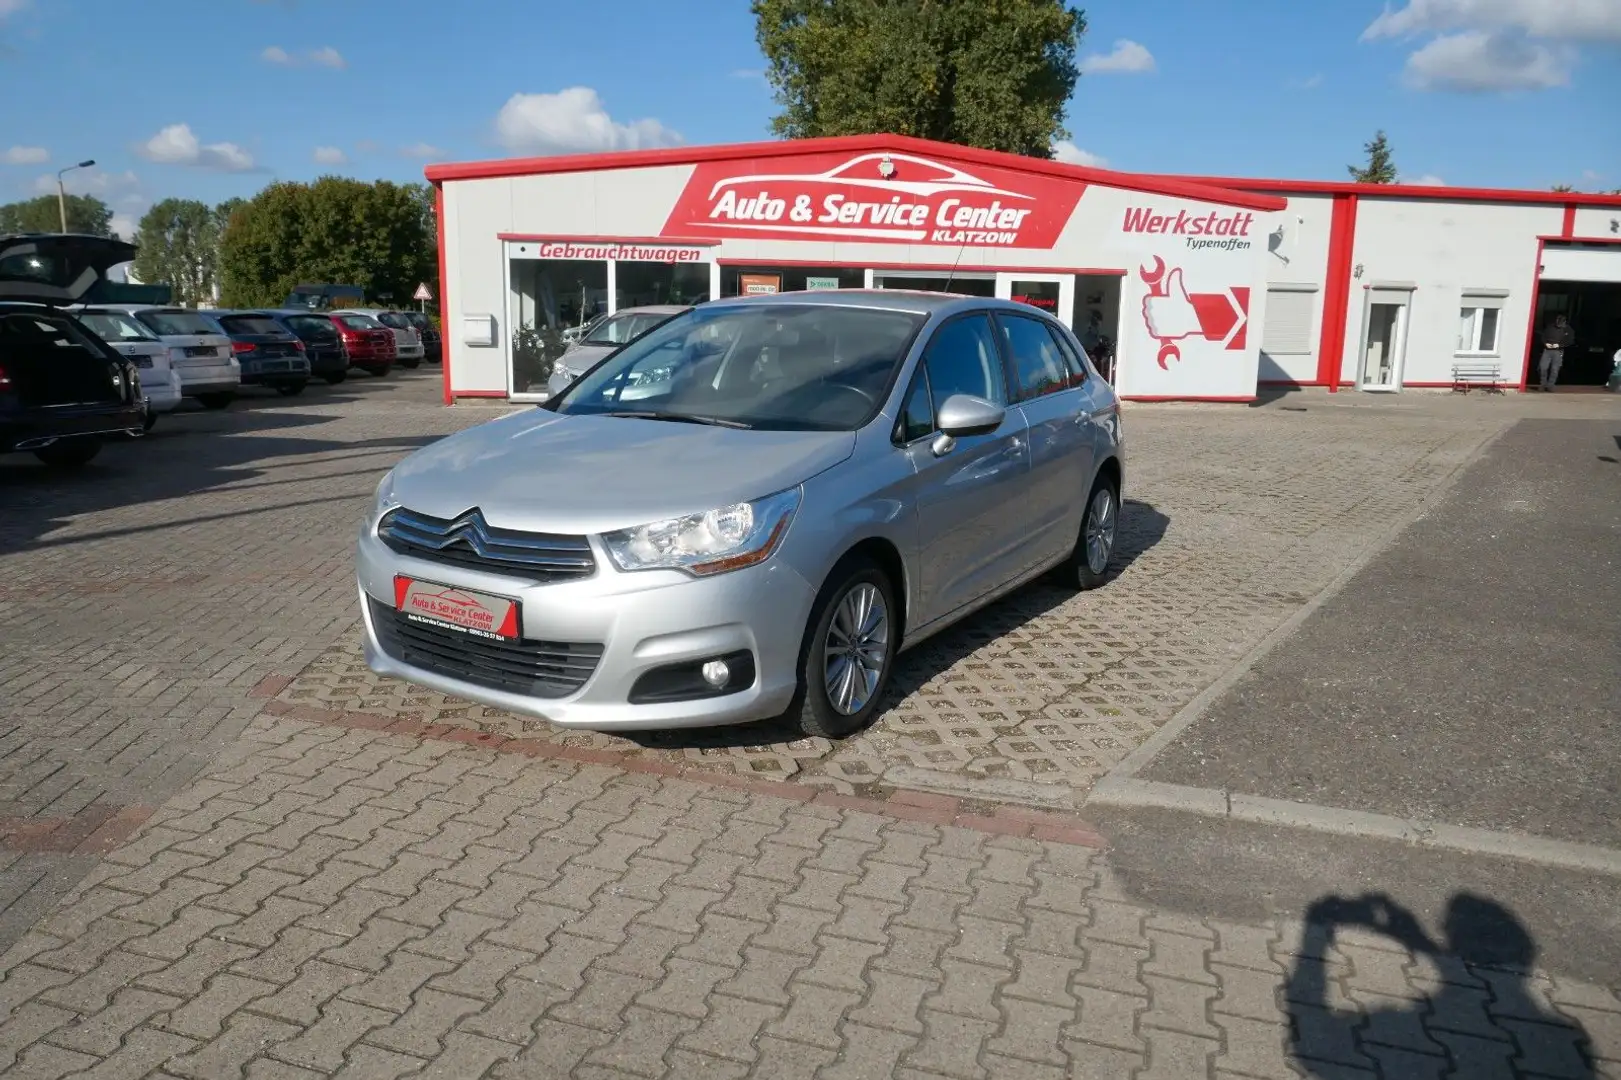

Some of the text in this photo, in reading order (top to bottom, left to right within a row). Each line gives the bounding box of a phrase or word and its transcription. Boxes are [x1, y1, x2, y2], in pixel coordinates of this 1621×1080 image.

[709, 190, 1032, 229] Auto & Service Center
[1122, 207, 1254, 236] Werkstatt
[931, 230, 1018, 244] KLATZOW
[1186, 237, 1251, 251] Typenoffen
[539, 243, 700, 264] Gebrauchtwagen
[412, 596, 494, 622] Auto & Service Center
[453, 615, 492, 630] KLATZOW
